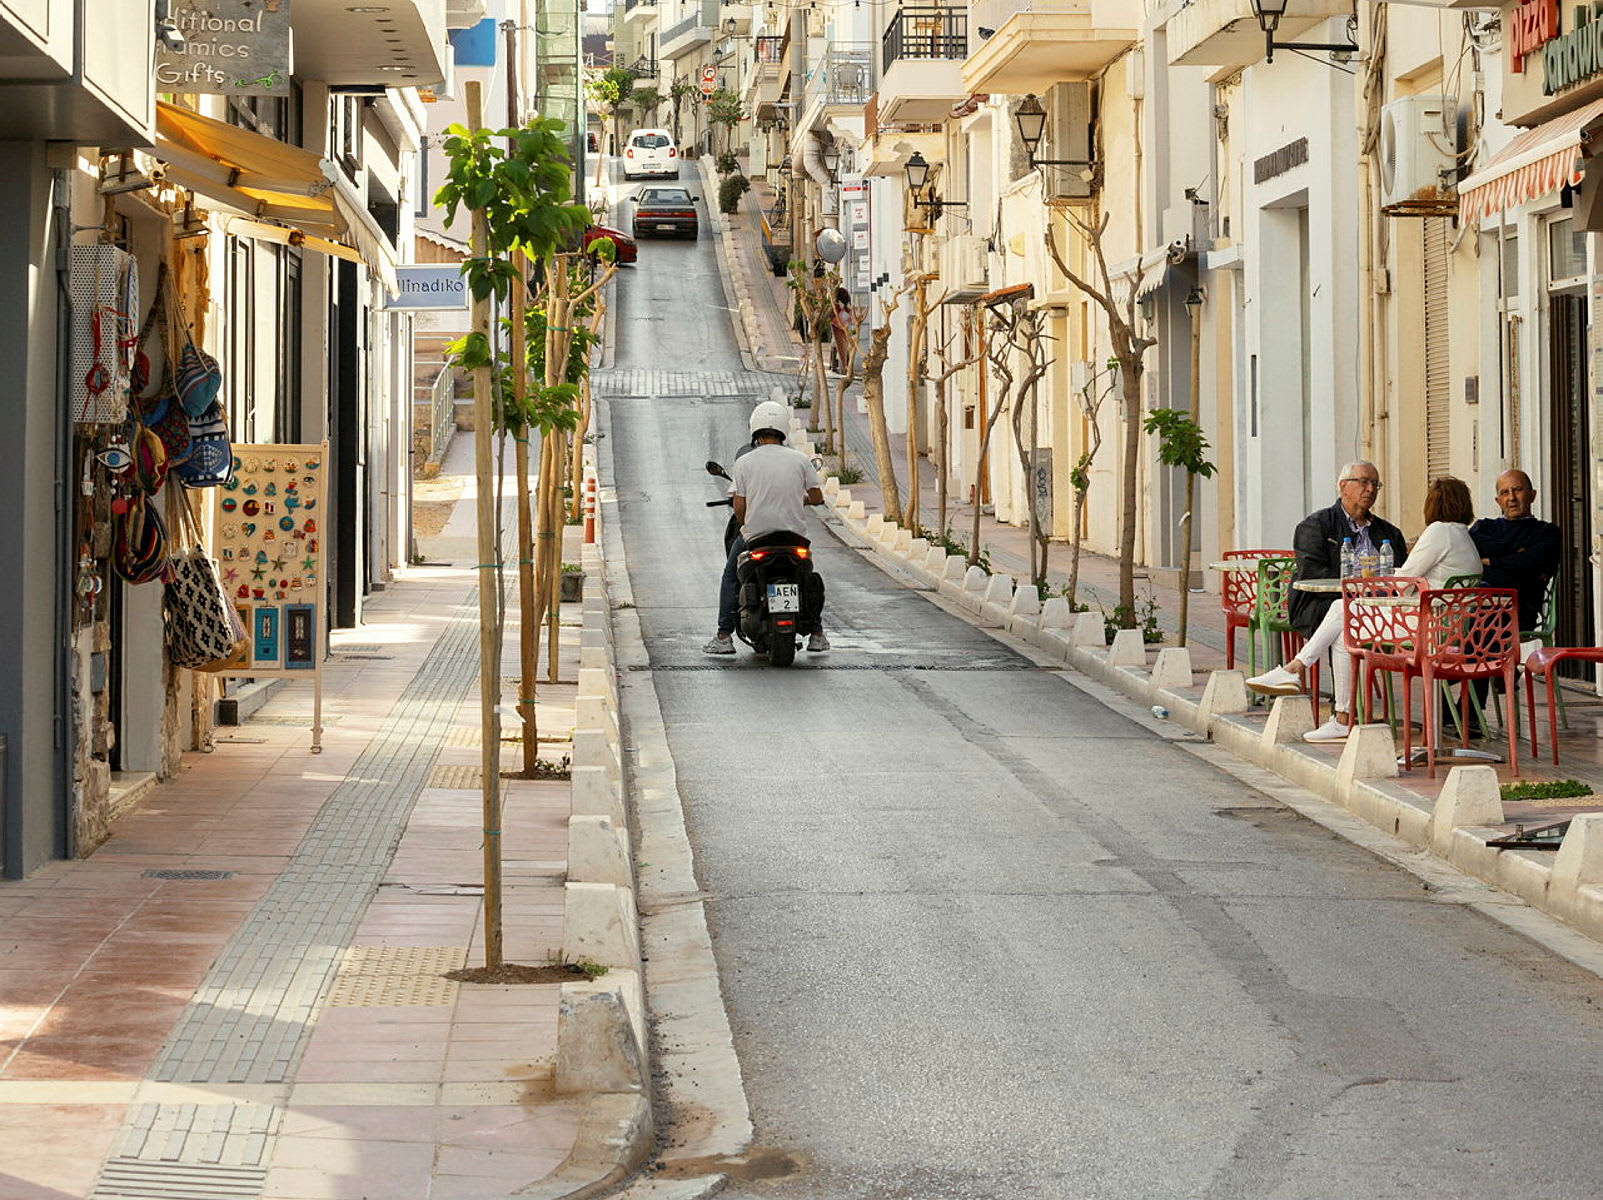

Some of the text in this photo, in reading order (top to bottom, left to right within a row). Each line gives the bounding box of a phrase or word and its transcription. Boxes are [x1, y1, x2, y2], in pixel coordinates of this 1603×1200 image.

[162, 6, 264, 33] ditional
[156, 62, 226, 84] Gifts
[776, 586, 797, 597] AEN
[783, 599, 791, 609] 2
